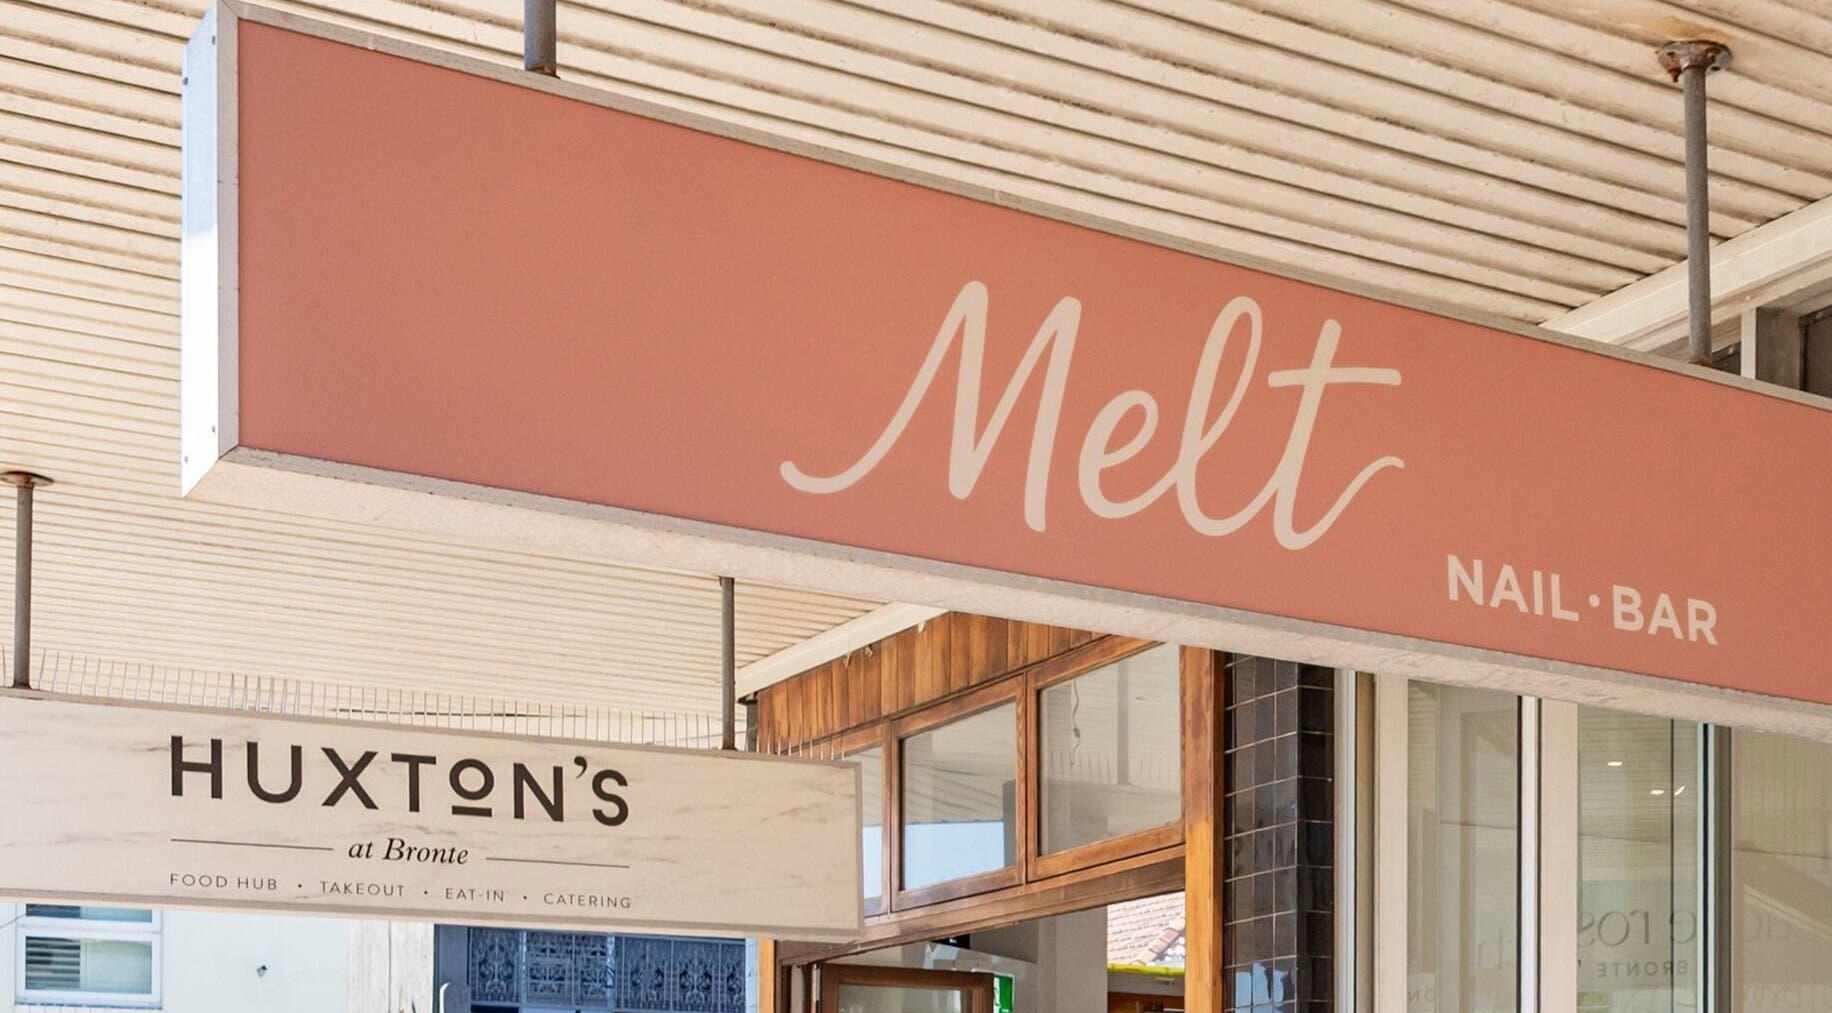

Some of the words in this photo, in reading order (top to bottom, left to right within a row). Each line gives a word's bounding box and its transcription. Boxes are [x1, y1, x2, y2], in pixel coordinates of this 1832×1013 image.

[780, 281, 1404, 550] Melt
[171, 735, 629, 826] HUXTON'S
[349, 841, 374, 861] at
[382, 838, 469, 865] Bronte
[170, 873, 229, 890] FOOD
[236, 877, 278, 892] HUB
[320, 880, 406, 897] TAKEOUT
[444, 887, 505, 903] EAT-IN
[543, 892, 632, 909] CATERING
